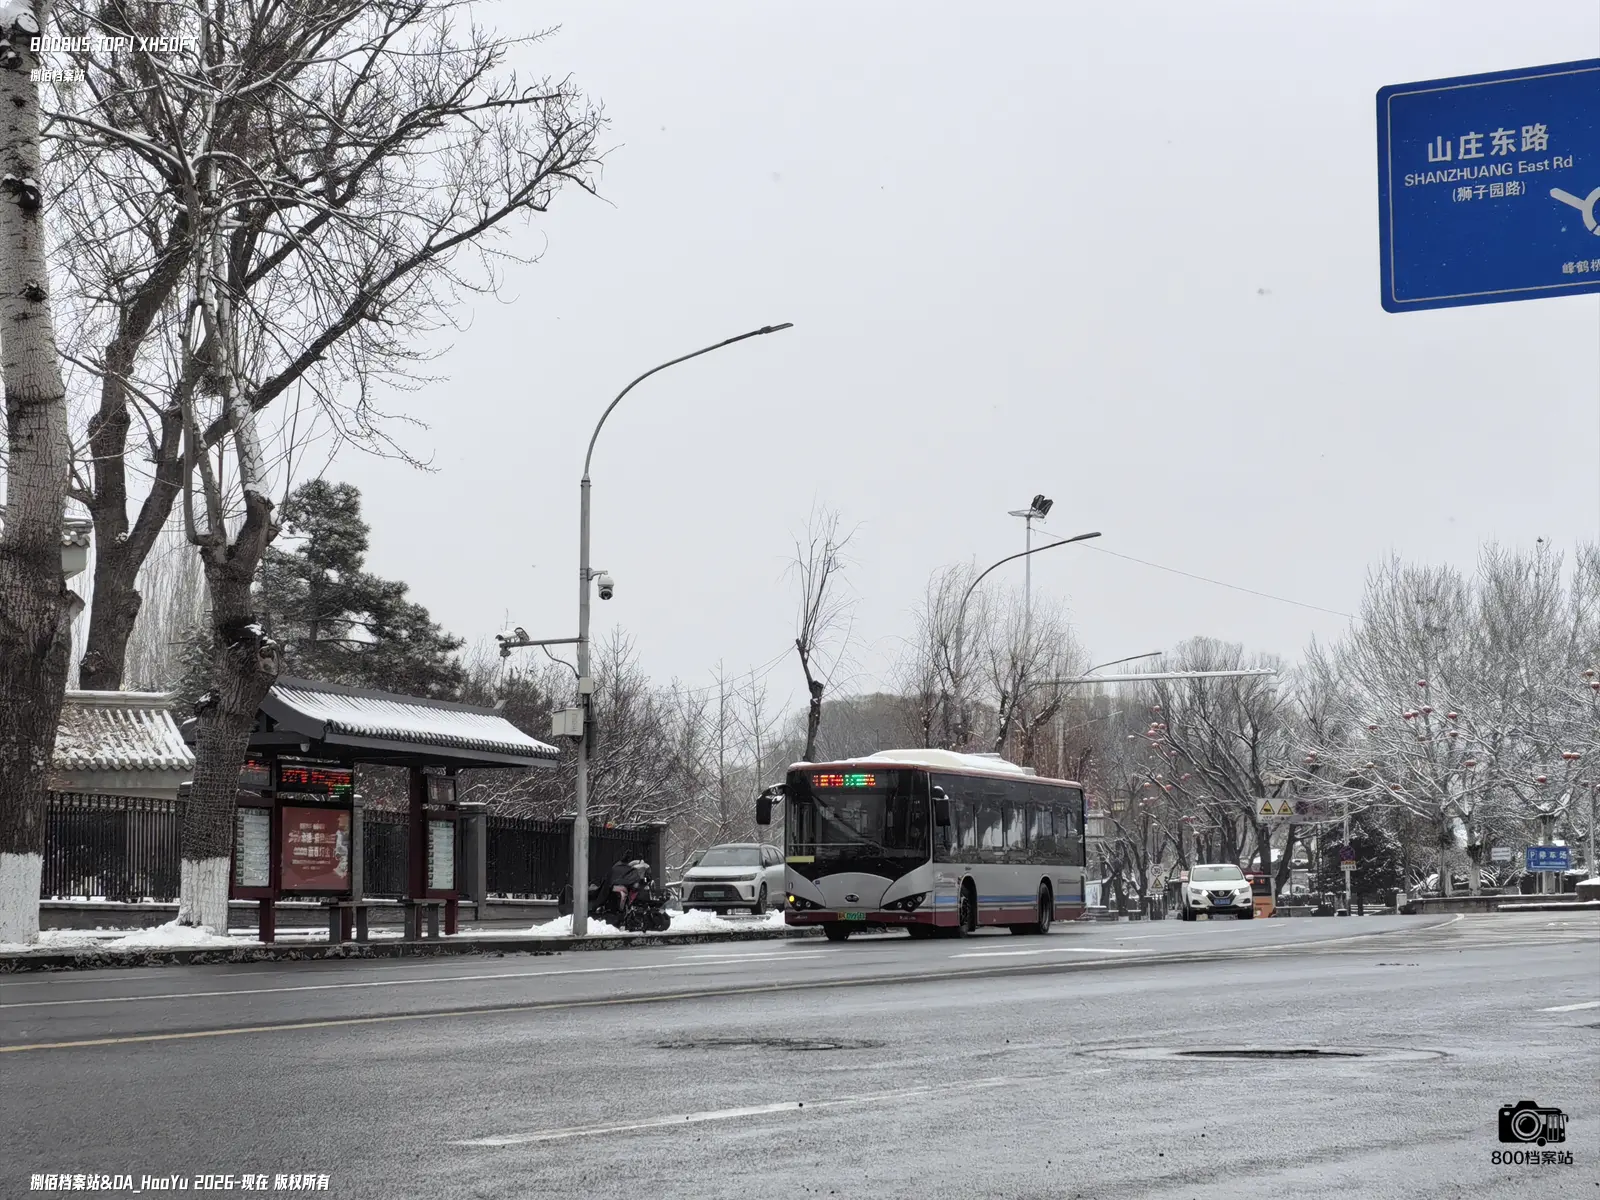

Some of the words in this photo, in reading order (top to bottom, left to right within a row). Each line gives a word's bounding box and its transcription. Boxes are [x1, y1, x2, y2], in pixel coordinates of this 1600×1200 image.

[1428, 122, 1549, 162] 山庄东路
[1404, 162, 1513, 186] SHANZHUANG
[1518, 158, 1550, 174] East
[1553, 154, 1574, 169] Rd
[1452, 179, 1526, 202] (狮子园路)
